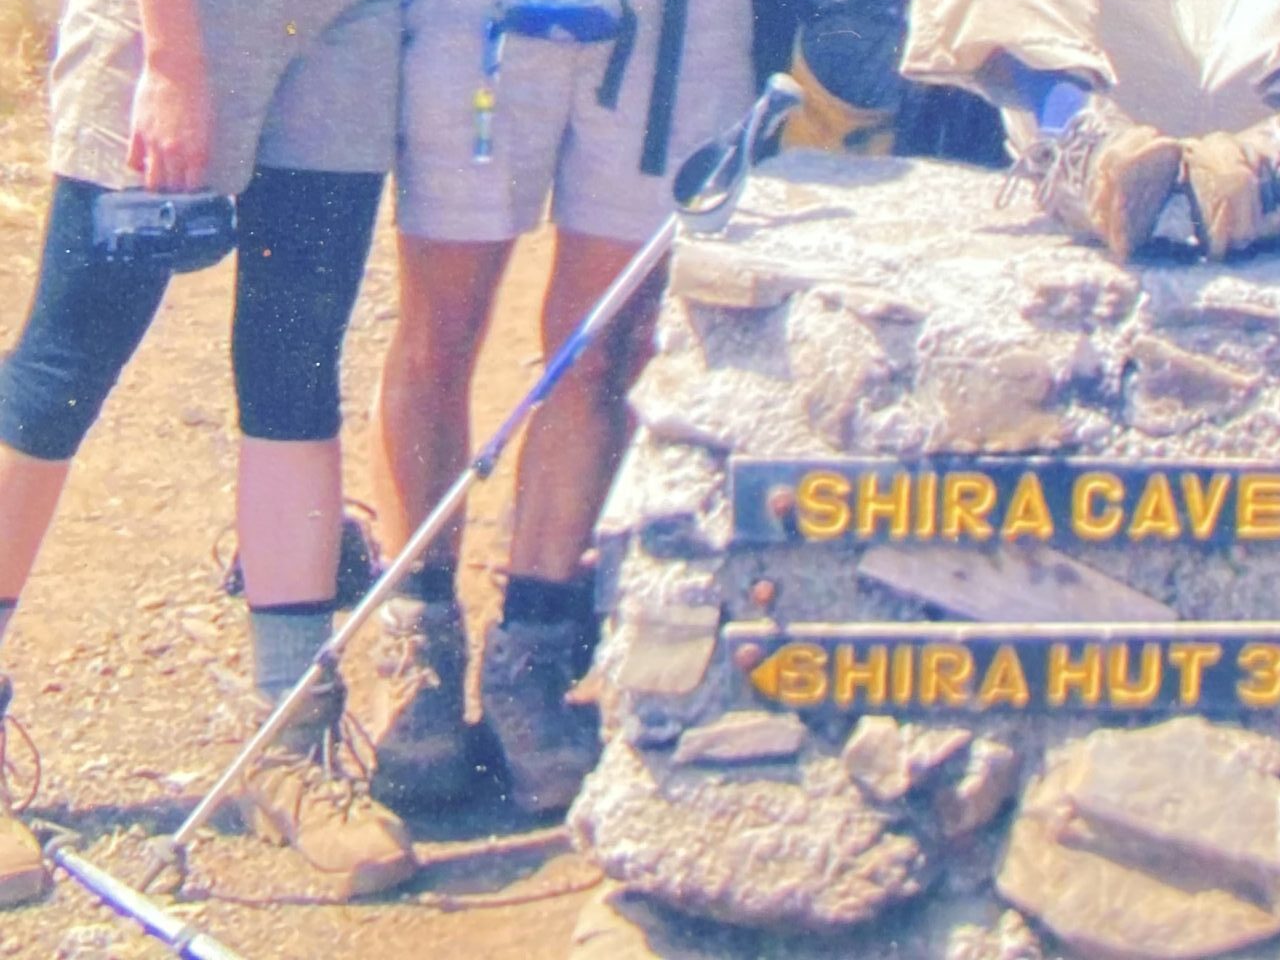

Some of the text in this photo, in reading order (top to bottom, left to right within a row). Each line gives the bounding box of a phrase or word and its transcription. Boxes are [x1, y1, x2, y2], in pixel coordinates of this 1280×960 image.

[799, 471, 1054, 541] SHIRA
[776, 642, 1031, 709] SHIRA
[1047, 642, 1222, 708] HUT
